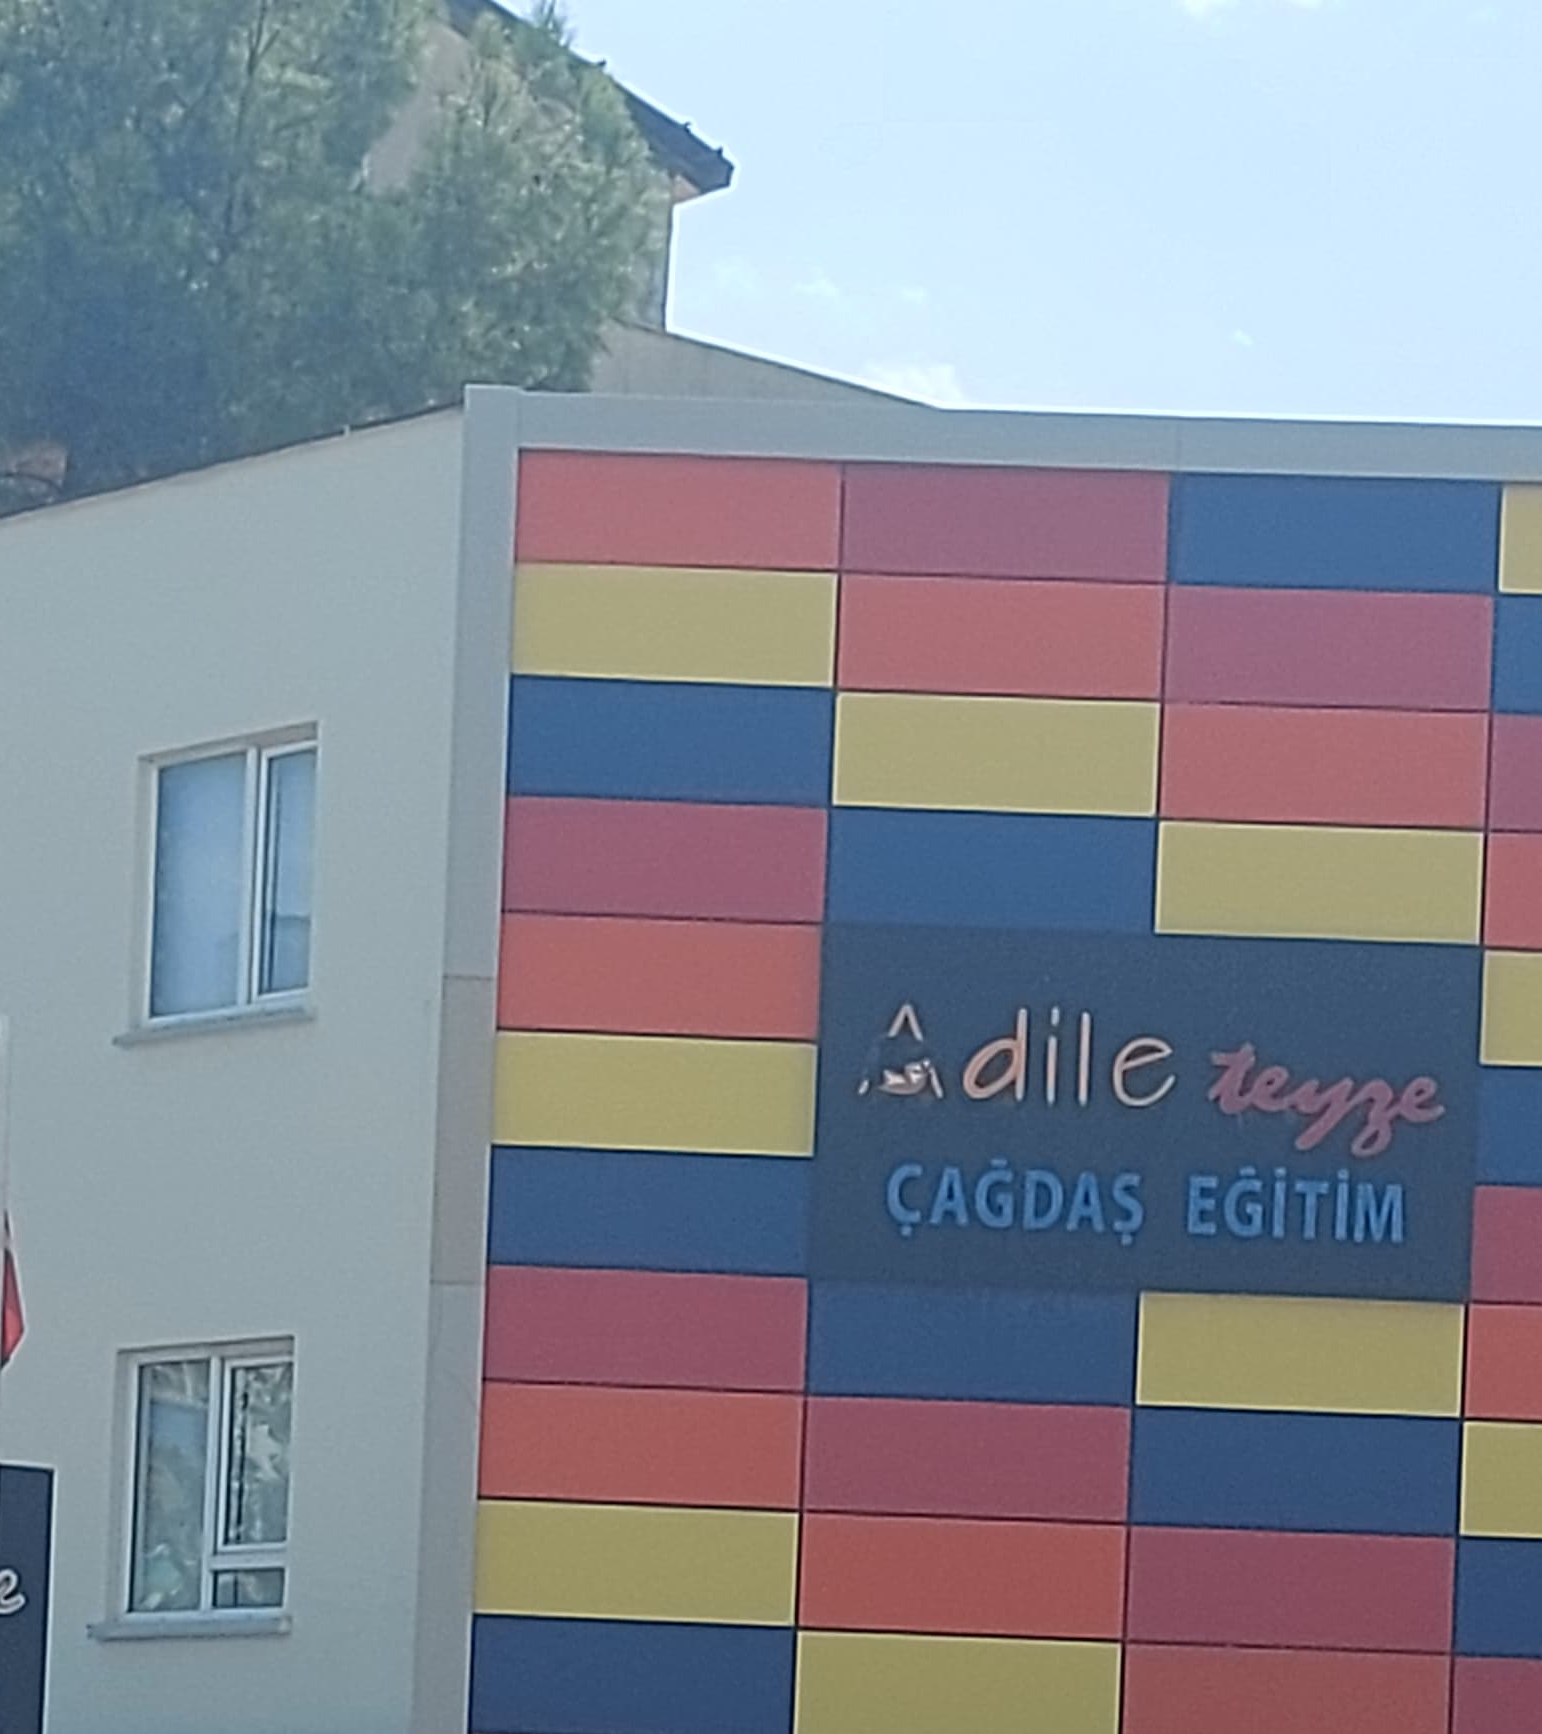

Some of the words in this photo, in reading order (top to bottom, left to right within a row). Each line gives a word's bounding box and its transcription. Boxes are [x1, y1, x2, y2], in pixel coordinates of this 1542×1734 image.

[859, 1003, 1175, 1107] Adile
[1210, 1043, 1445, 1156] teyze
[886, 1158, 1144, 1246] ÇAĞDAŞ
[1186, 1167, 1405, 1243] EĞİTİM
